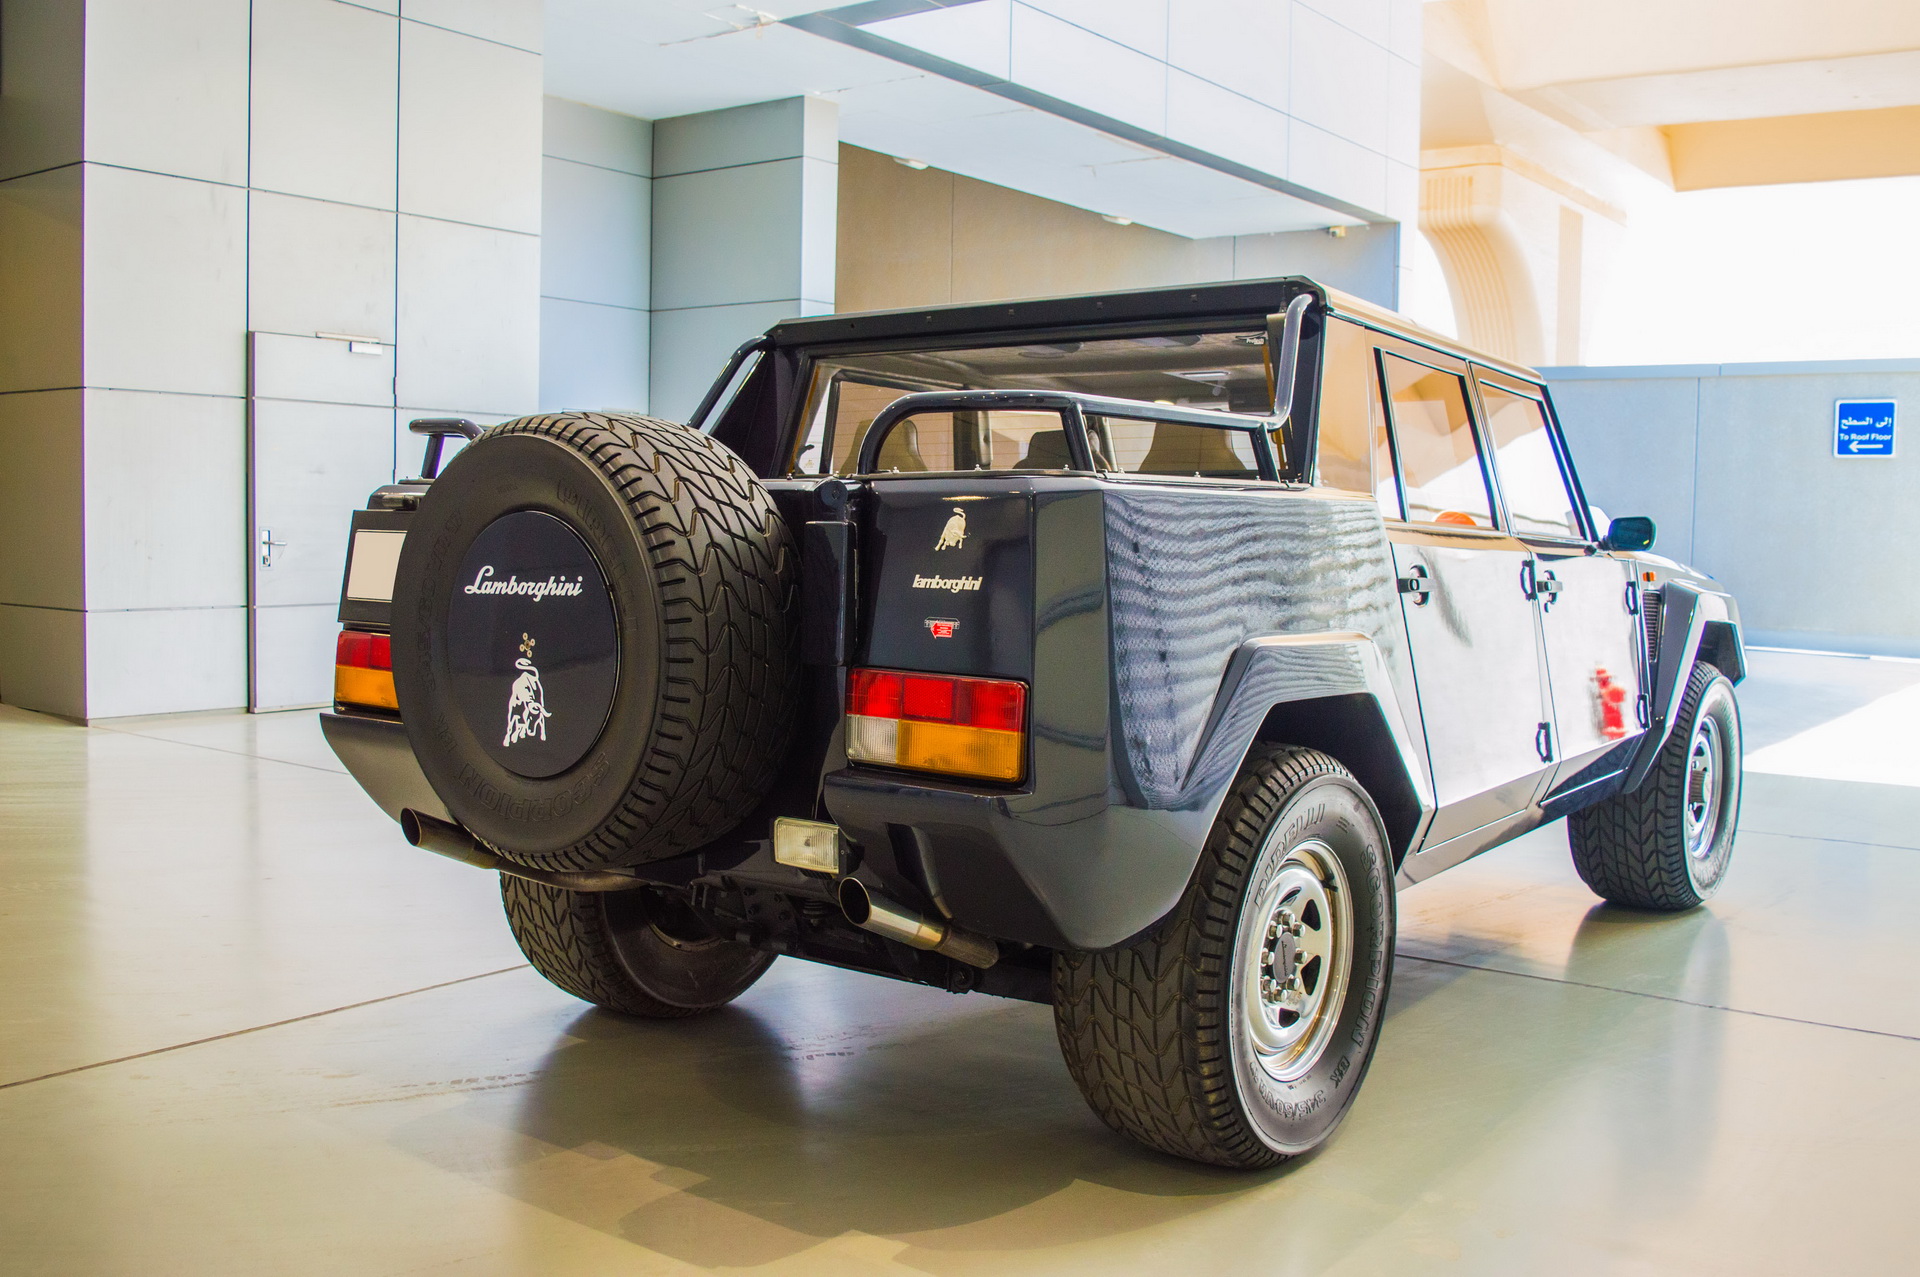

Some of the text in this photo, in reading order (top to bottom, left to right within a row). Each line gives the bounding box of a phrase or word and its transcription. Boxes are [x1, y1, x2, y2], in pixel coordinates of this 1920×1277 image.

[1875, 416, 1892, 428] إلى
[1840, 433, 1850, 441] To
[1871, 433, 1892, 441] Floor
[464, 565, 583, 602] Lamborghini
[912, 574, 983, 594] lamborghini
[1350, 843, 1385, 1049] SCORPION
